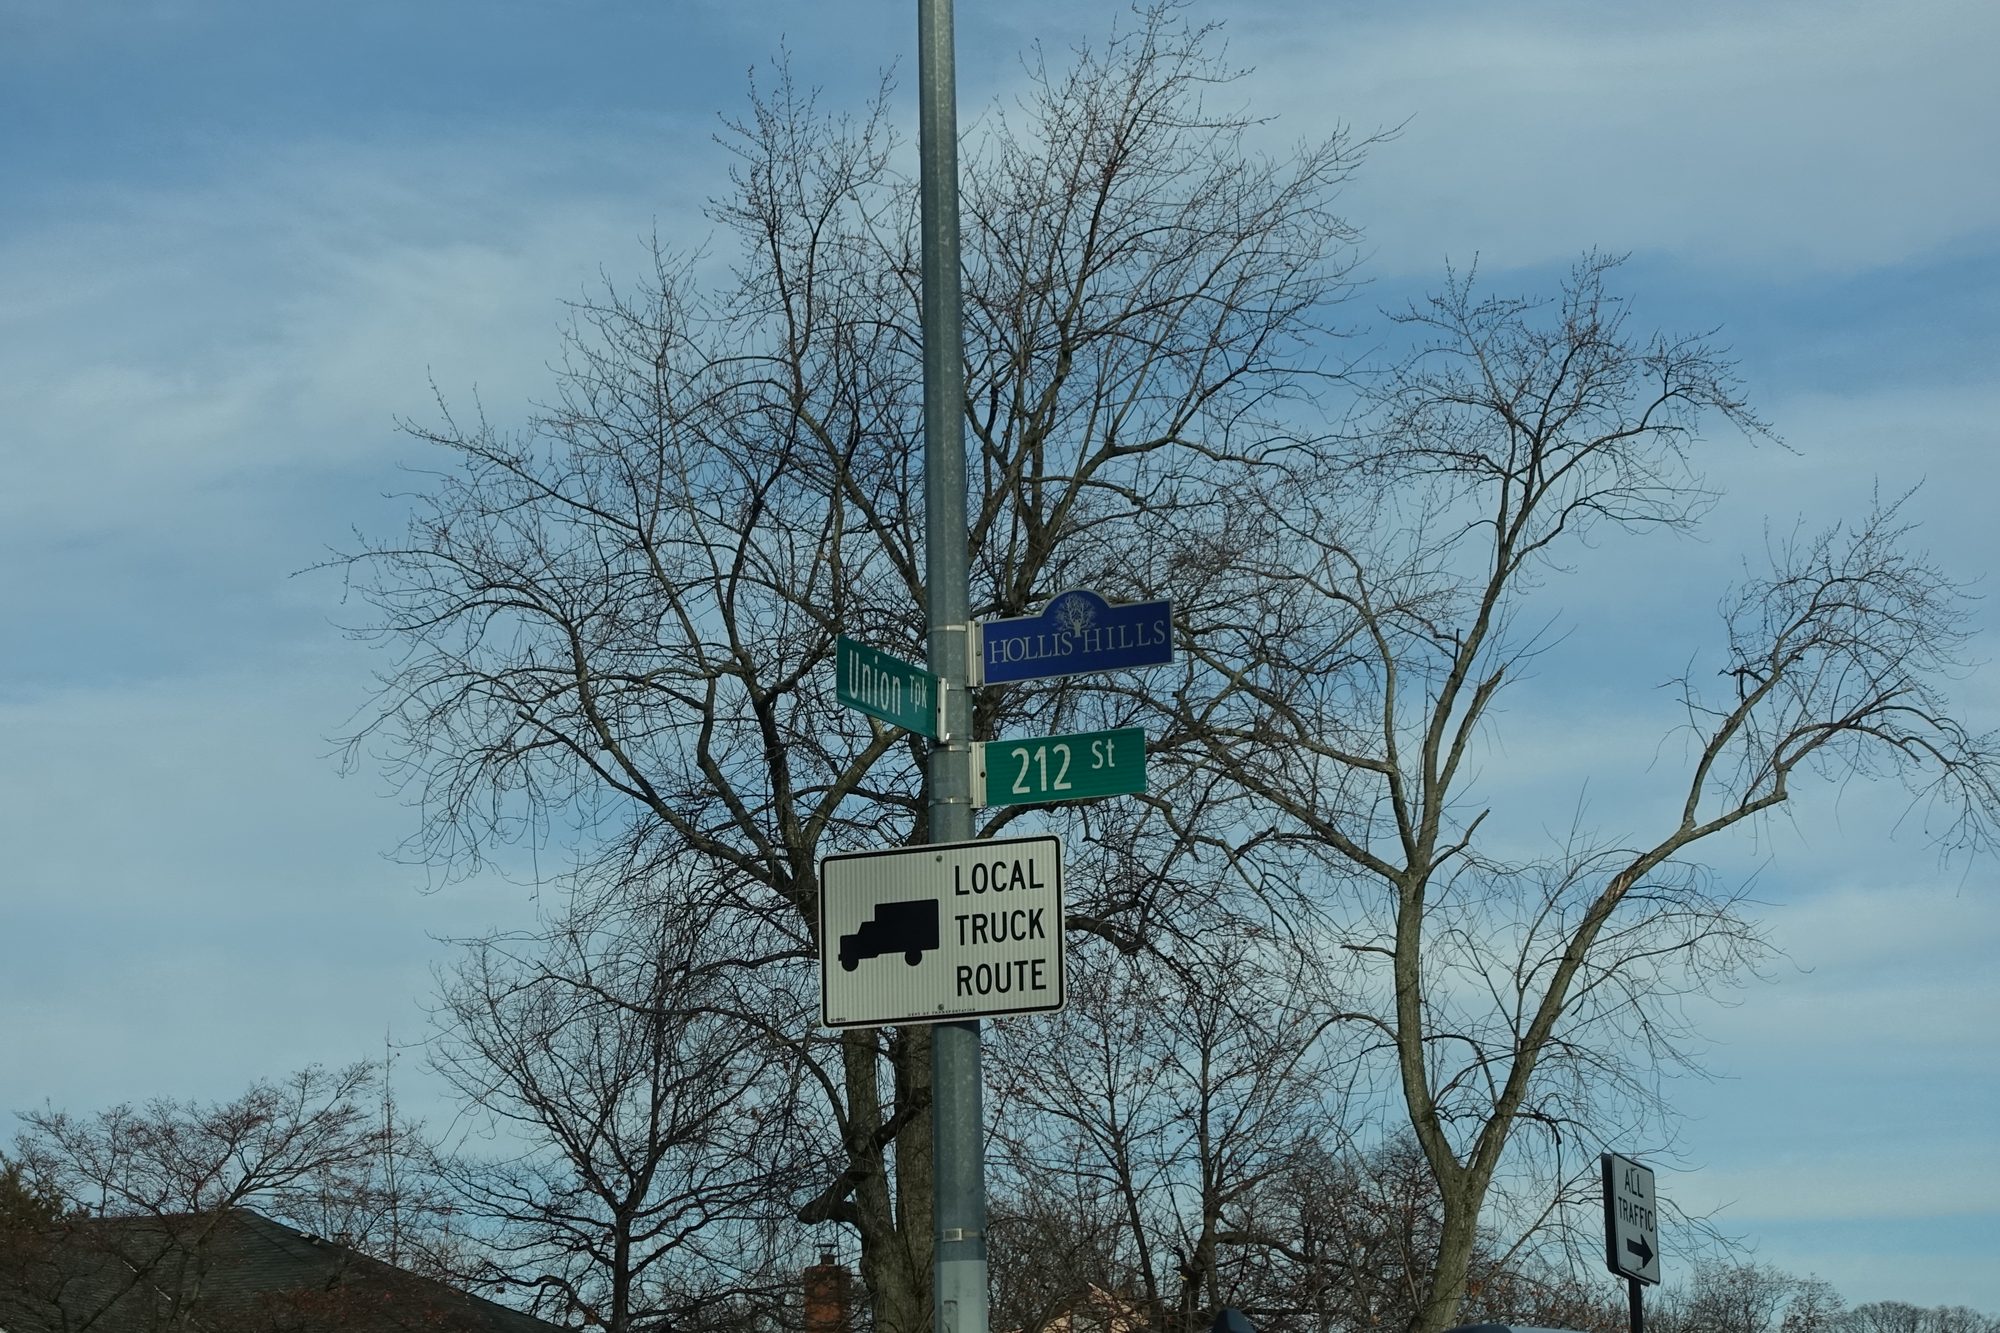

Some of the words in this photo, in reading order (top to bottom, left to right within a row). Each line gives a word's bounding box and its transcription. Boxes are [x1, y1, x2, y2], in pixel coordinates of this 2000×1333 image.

[989, 631, 1073, 664] HOLLIS
[1082, 620, 1166, 653] HILLS
[849, 649, 901, 716] Union
[909, 674, 927, 713] Tpk
[1011, 743, 1072, 795] 212
[1091, 738, 1115, 770] St
[954, 858, 1044, 896] LOCAL
[954, 907, 1046, 946] TRUCK
[956, 958, 1047, 997] ROUTE
[1624, 1168, 1644, 1198] ALL
[1618, 1196, 1654, 1232] TRAFFIC
